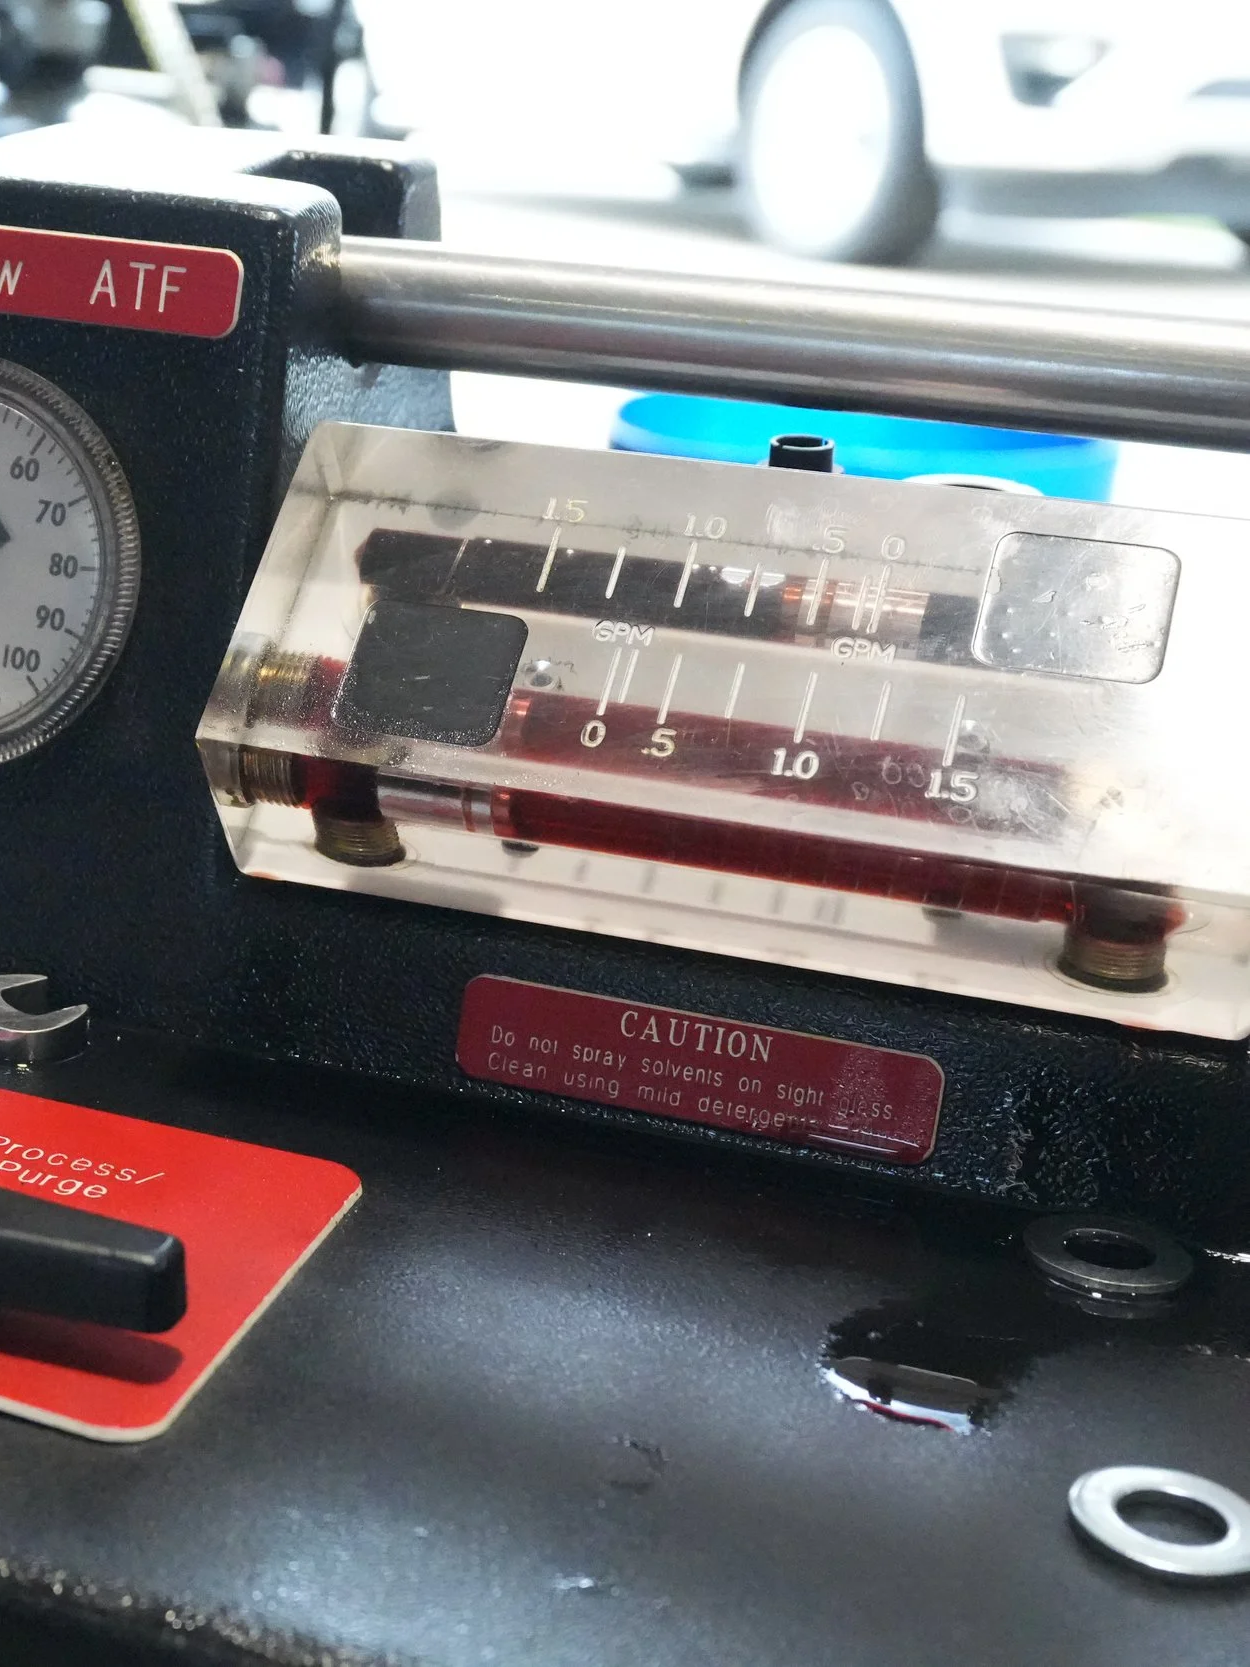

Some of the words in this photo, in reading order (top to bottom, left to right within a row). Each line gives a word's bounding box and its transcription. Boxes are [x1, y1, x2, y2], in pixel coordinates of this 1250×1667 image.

[88, 259, 188, 313] ATF
[9, 455, 40, 482] 60
[36, 499, 67, 526] 70
[541, 497, 590, 523] 1.5
[683, 512, 729, 540] 1.0
[811, 524, 850, 554] .5
[880, 534, 907, 560] 0
[49, 552, 78, 579] 80
[35, 605, 66, 631] 90
[591, 619, 657, 647] GPM
[2, 643, 41, 672] 100
[831, 636, 898, 664] GPM
[580, 720, 608, 748] 0
[640, 727, 678, 758] .5
[769, 747, 820, 780] 1.0
[923, 768, 980, 803] 1.5
[620, 1010, 774, 1064] CAUTION
[488, 1052, 547, 1080] Clean
[564, 1071, 620, 1098] using
[638, 1084, 681, 1107] mild
[491, 1025, 516, 1047] Do
[529, 1036, 558, 1055] not
[573, 1044, 627, 1070] spray
[641, 1057, 724, 1087] solvents
[738, 1076, 762, 1094] on
[777, 1081, 825, 1107] sight
